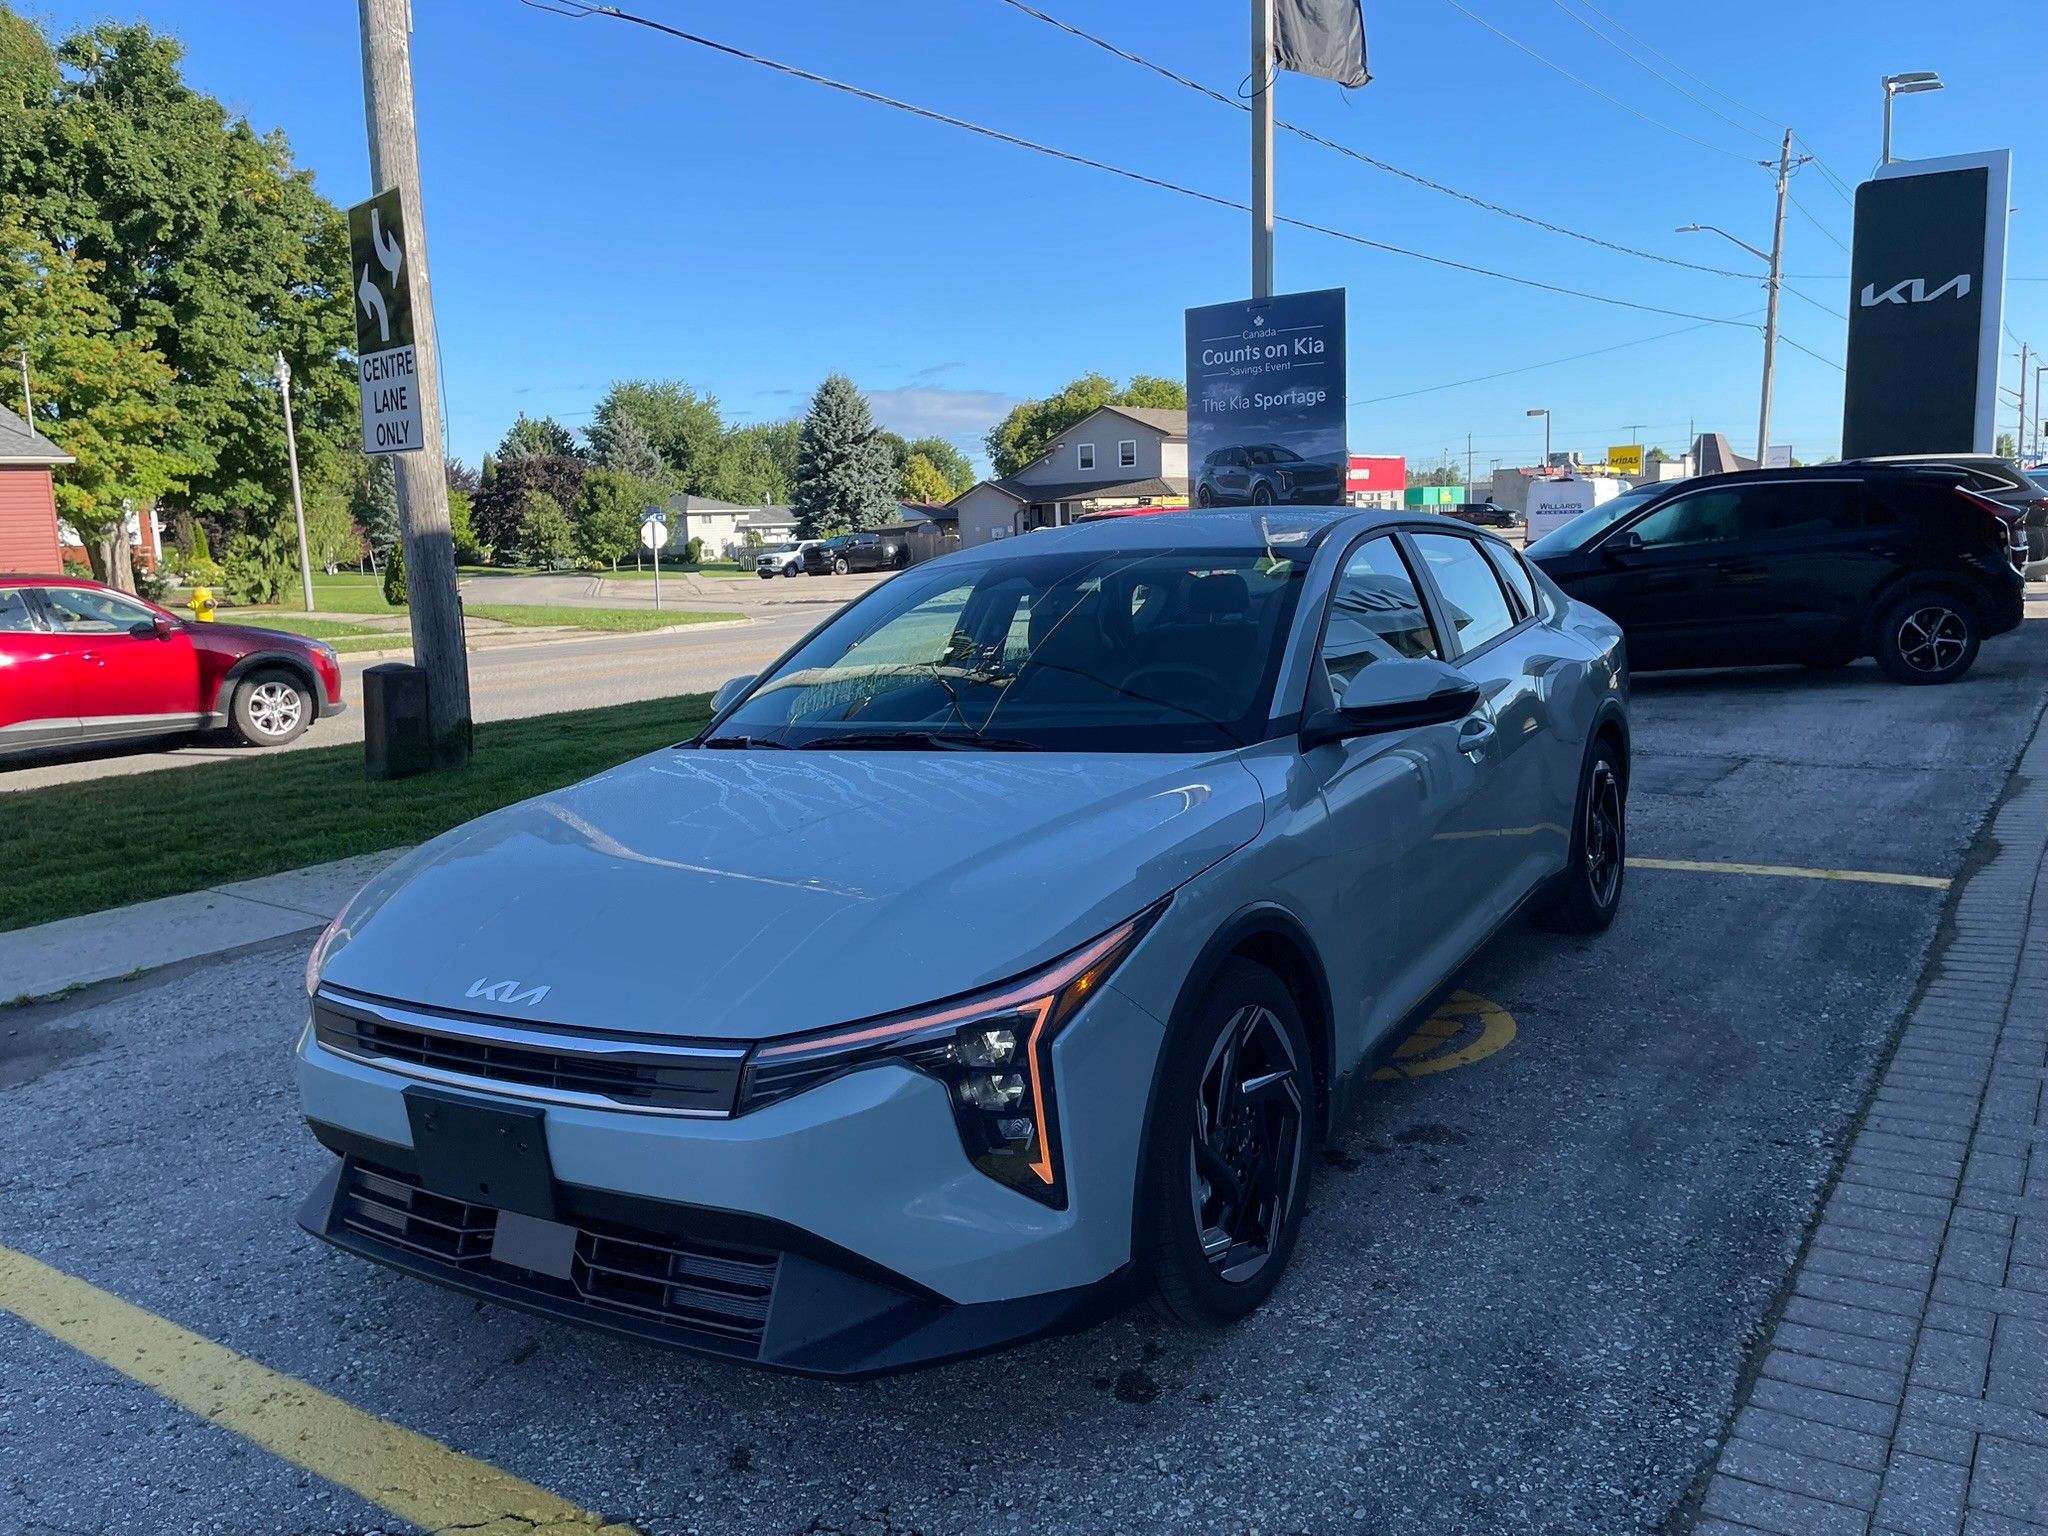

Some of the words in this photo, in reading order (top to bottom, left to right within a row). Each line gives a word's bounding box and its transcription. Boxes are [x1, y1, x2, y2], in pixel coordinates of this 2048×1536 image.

[1861, 274, 1970, 306] KIA
[1242, 328, 1276, 340] Canada
[1202, 345, 1260, 365] Counts
[1264, 344, 1287, 358] on
[1294, 337, 1324, 355] Kia
[364, 350, 413, 382] CENTRE
[1230, 364, 1263, 376] Savings
[1265, 361, 1291, 372] Event
[374, 386, 407, 414] LANE
[1202, 398, 1226, 412] The
[1229, 395, 1250, 410] Kia
[1254, 390, 1326, 410] Sportage
[376, 420, 410, 446] ONLY
[465, 976, 552, 1007] KIA
